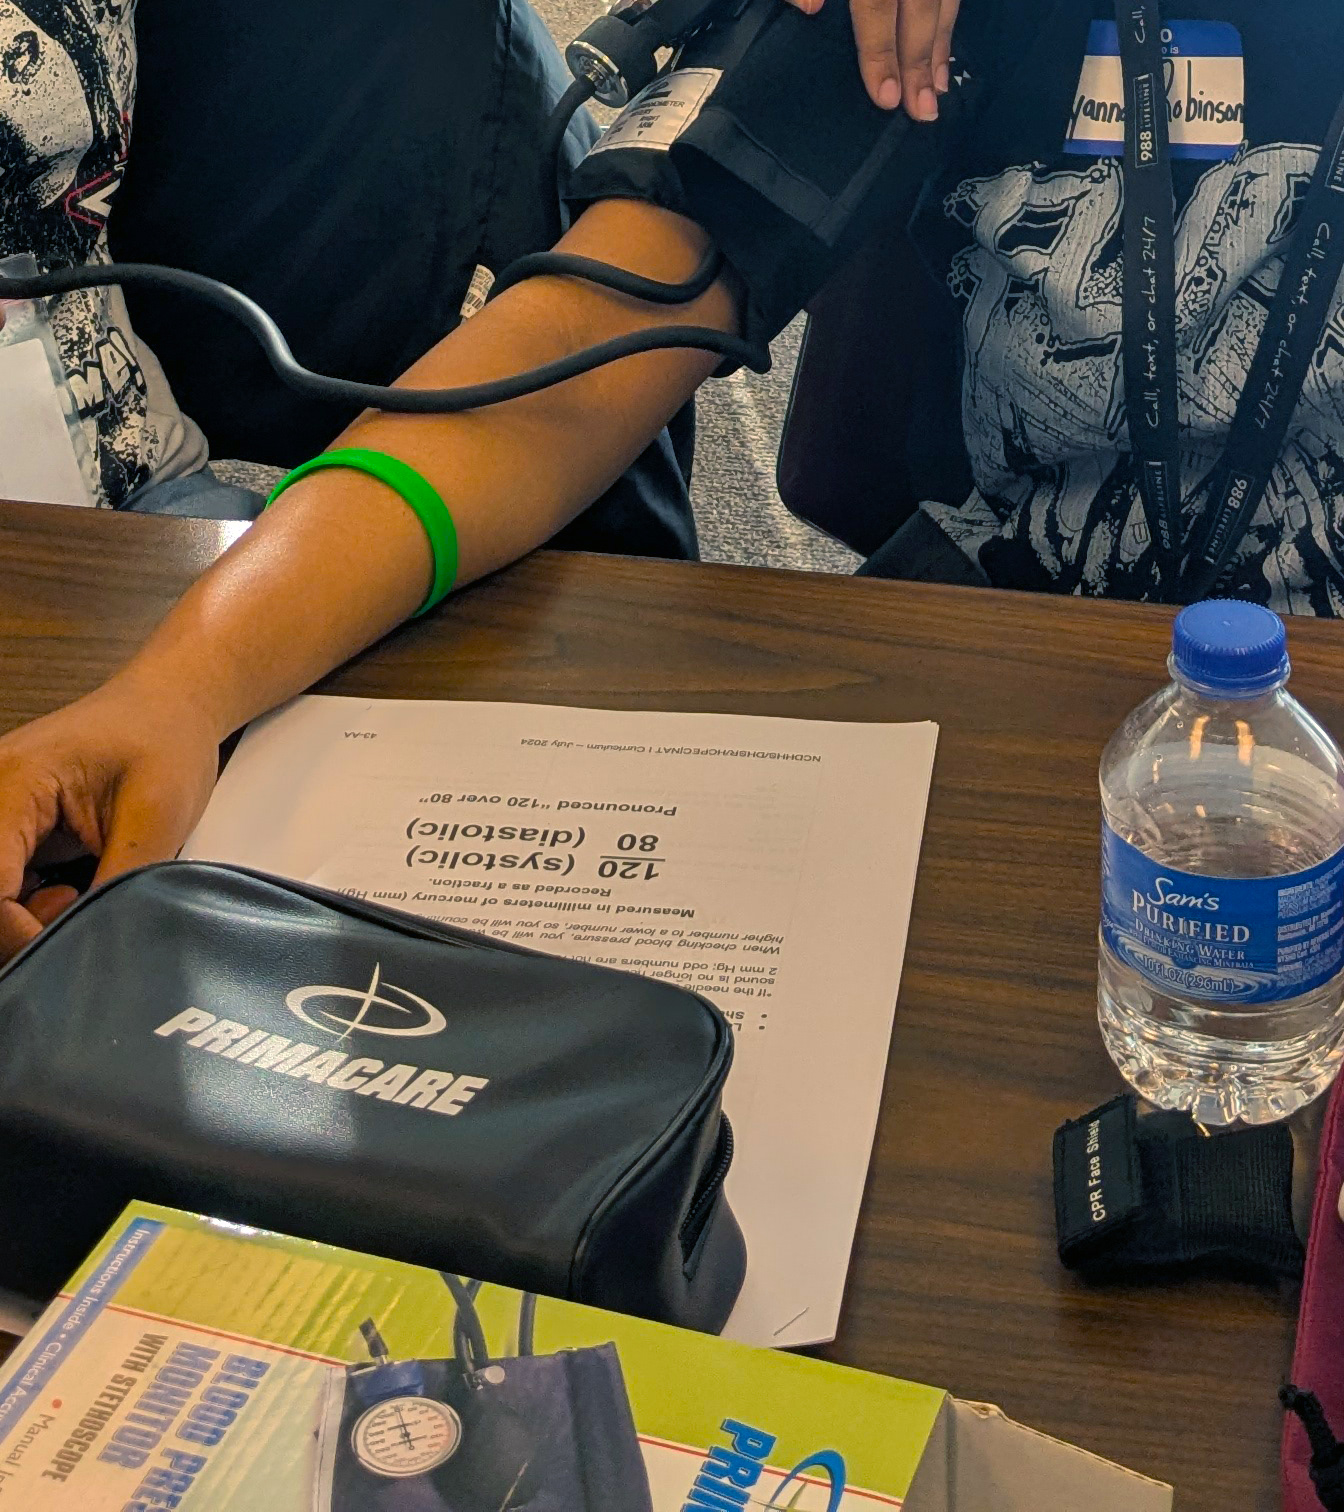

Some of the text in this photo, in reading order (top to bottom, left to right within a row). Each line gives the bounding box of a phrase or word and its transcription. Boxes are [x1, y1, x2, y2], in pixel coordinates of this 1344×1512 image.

[1140, 130, 1153, 162] 988
[1142, 216, 1156, 261] 24/7
[1141, 266, 1155, 307] chat
[1147, 312, 1155, 331] or
[1287, 313, 1297, 335] or
[1272, 339, 1292, 379] chat
[1255, 383, 1280, 430] 24/7
[1227, 477, 1248, 510] 988
[520, 738, 549, 747] 2024
[550, 739, 574, 749] July
[587, 743, 646, 754] Curriculum
[457, 794, 502, 804] over
[557, 800, 678, 817] Pronounced
[406, 817, 660, 853] 80 (diastolic)
[406, 845, 660, 882] 120 (systolic)
[429, 877, 612, 898] Recorded as a fraction.
[1147, 877, 1220, 911] Sam's
[372, 890, 695, 918] Measured in millimeters of mercury (mm
[1132, 889, 1250, 943] PURIFIED
[471, 918, 489, 927] be
[490, 918, 512, 927] will
[515, 920, 541, 930] you
[543, 921, 560, 930] so
[491, 929, 508, 937] be
[513, 930, 534, 939] will
[540, 931, 565, 941] you
[619, 926, 657, 936] lower
[670, 930, 685, 938] to
[691, 931, 737, 942] number
[635, 937, 672, 948] blood
[741, 934, 784, 946] higher
[678, 941, 737, 954] checking
[742, 944, 781, 955] When
[595, 957, 617, 965] are
[621, 959, 679, 969] numbers
[682, 962, 709, 971] odd
[740, 965, 766, 974] mm
[769, 967, 778, 976] 2
[650, 970, 693, 982] longer
[697, 973, 714, 981] no
[719, 974, 730, 983] is
[734, 975, 776, 985] sound
[1184, 972, 1235, 993] (296mL)
[733, 986, 755, 996] the
[154, 1006, 490, 1116] PRIMACARE
[1086, 1119, 1107, 1222] CPR Face Shield
[89, 1229, 151, 1295] Instructions
[62, 1294, 100, 1331] Inside
[23, 1341, 63, 1389] Clinical
[97, 1341, 223, 1470] MONITOR
[176, 1353, 271, 1448] BLOOD
[41, 1332, 169, 1483] WITH STETHOSCOPE
[3, 1414, 55, 1467] Manual
